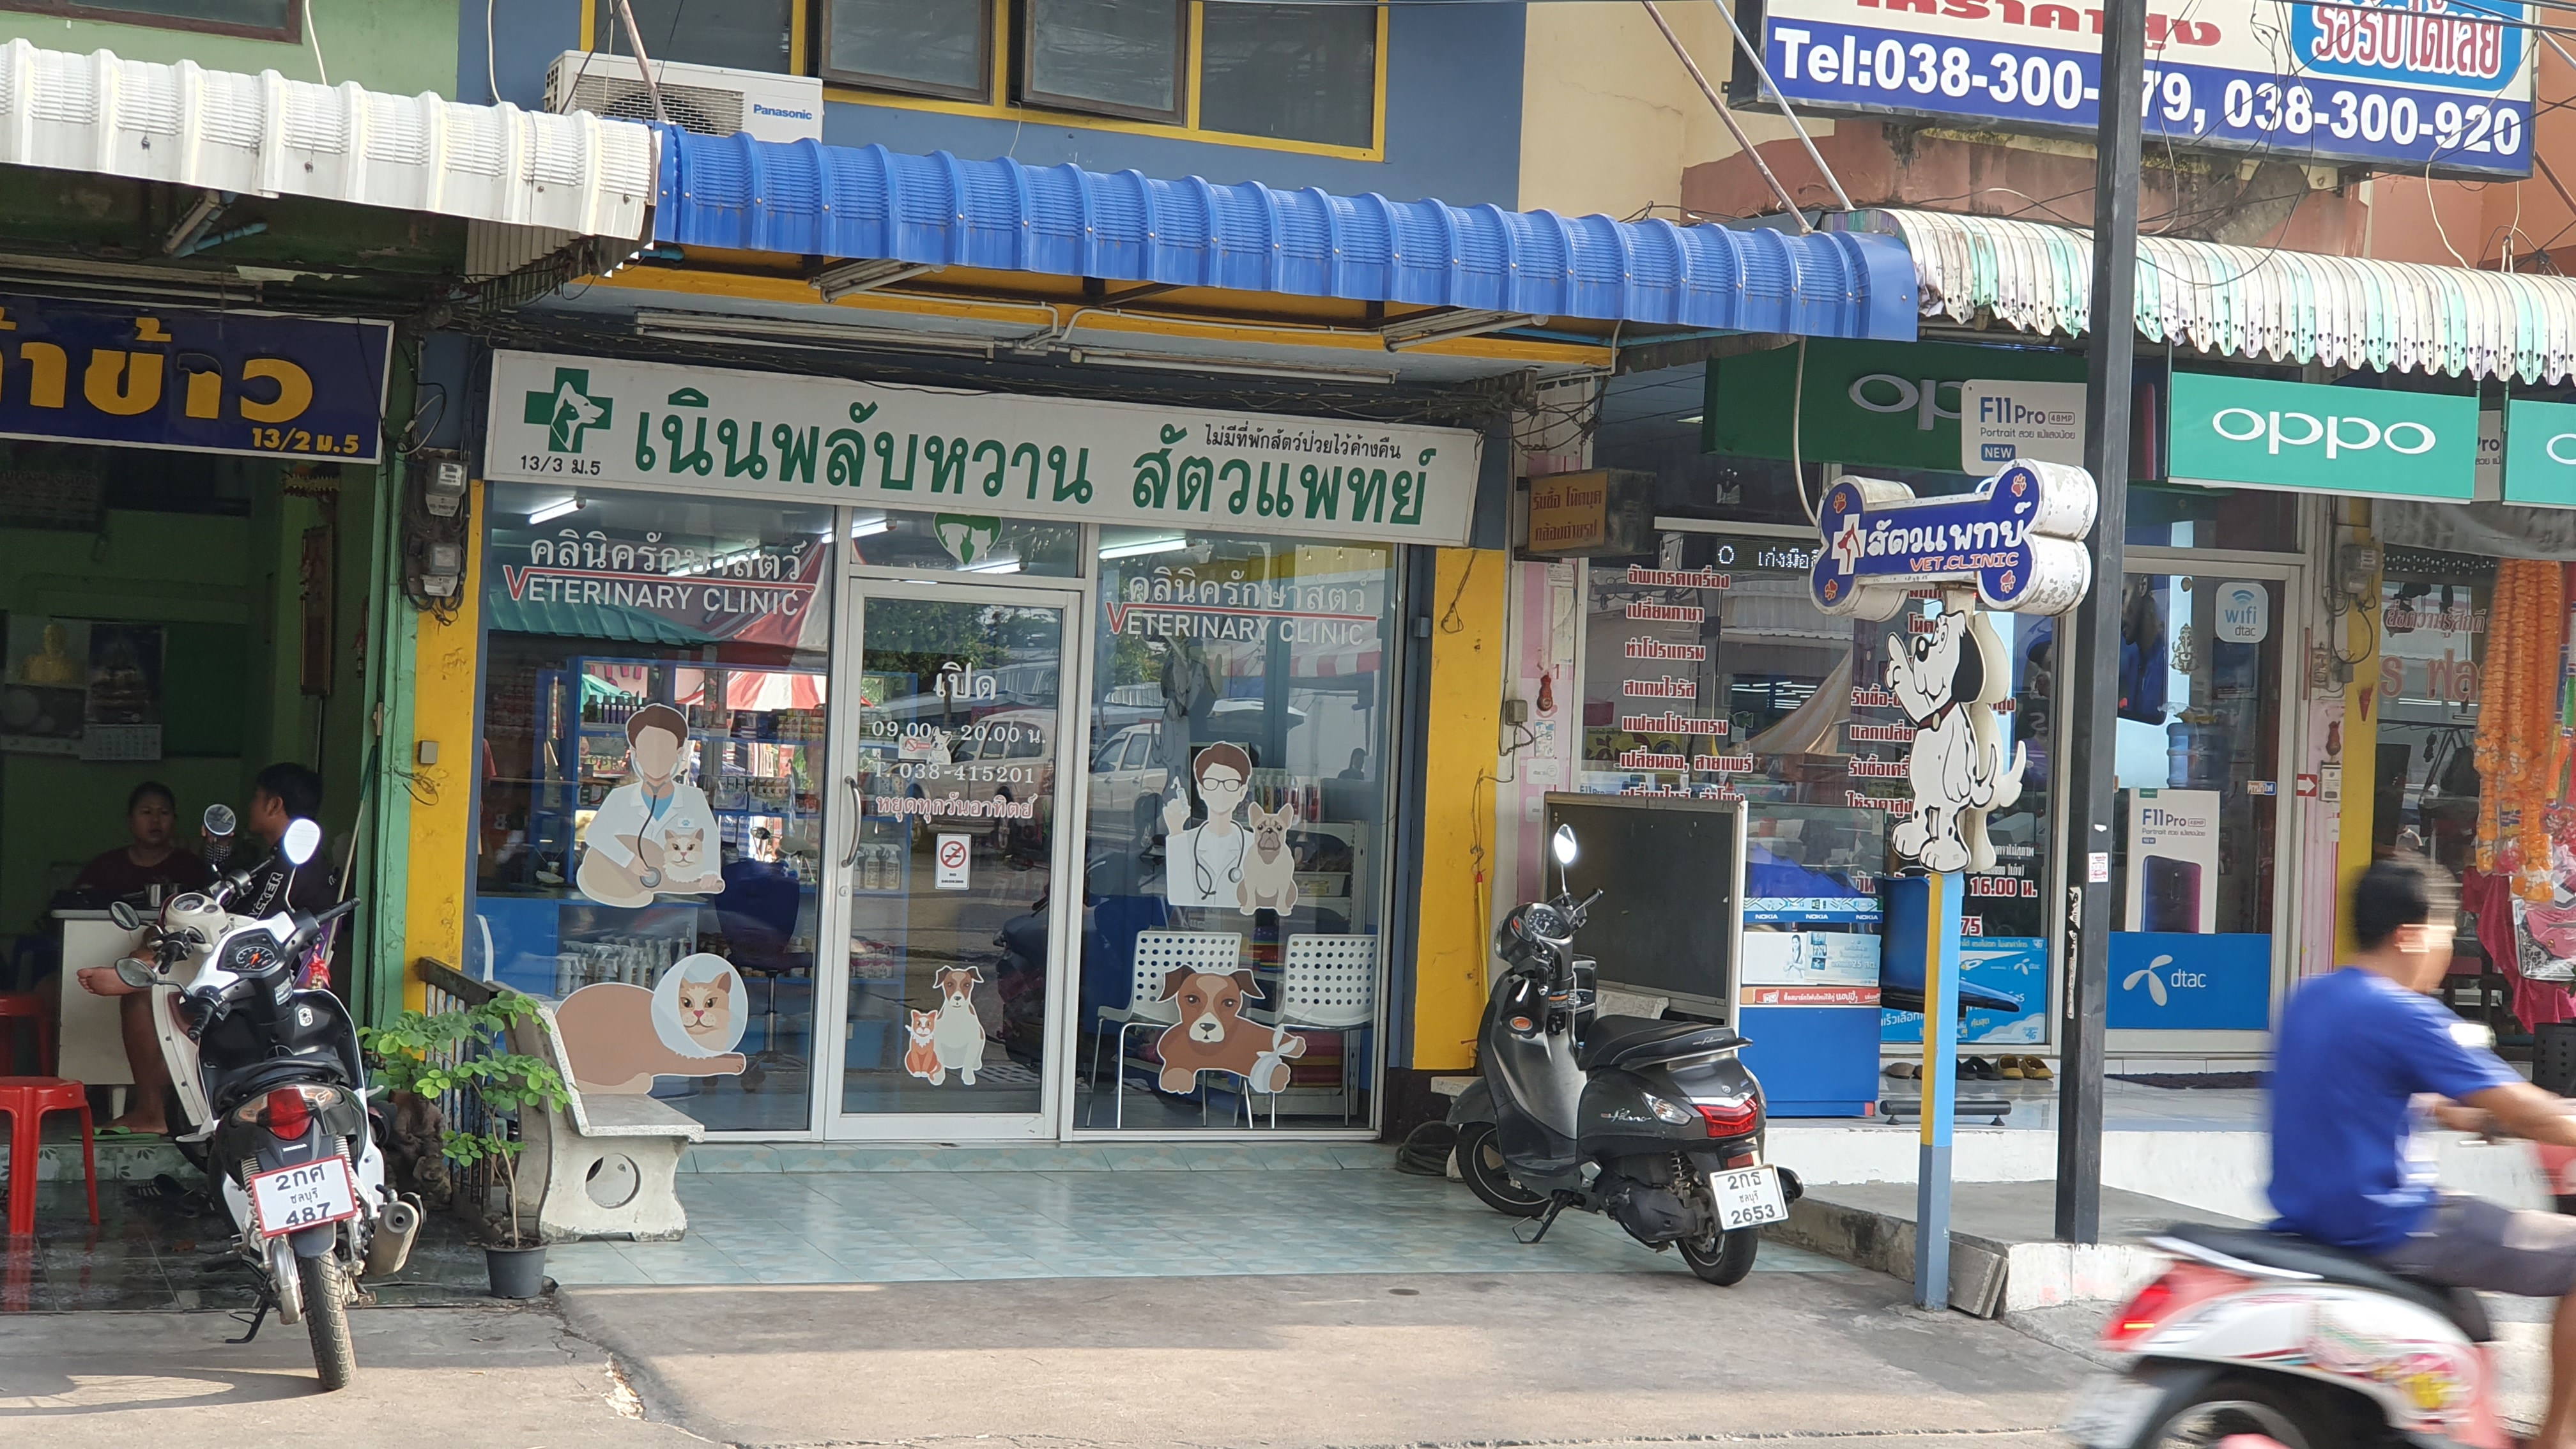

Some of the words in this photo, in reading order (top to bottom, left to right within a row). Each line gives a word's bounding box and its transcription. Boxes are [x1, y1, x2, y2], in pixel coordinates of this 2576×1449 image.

[2313, 0, 2501, 77] รอรบได้เลย
[1774, 27, 2205, 134] Tel:038-300-79,
[2224, 79, 2521, 155] 038-300-920
[753, 103, 813, 120] Panasonic
[1981, 397, 2011, 424] F11
[2015, 405, 2046, 424] Pro
[252, 427, 310, 451] 13/2
[317, 434, 359, 454] ม.5
[1205, 421, 1401, 460] ไม่มีที่พักสัตว์ป่วยไว้ค้างคืน
[1981, 427, 2016, 438] Portrait
[2212, 408, 2436, 459] oppo
[520, 454, 563, 473] 13/3
[571, 459, 601, 475] ม.5
[636, 387, 1093, 504] เนินพลับหวาน
[1133, 423, 1437, 525] สัตวแพทย์
[1984, 447, 2012, 458] NEW
[1867, 501, 2032, 557] สัตวแพทย์
[530, 528, 807, 580] คลินิครักษาสัตว์
[1910, 552, 2020, 572] VET.CLINIC
[1628, 564, 1730, 589] อัพเกรดเครื่อง
[503, 565, 693, 610] VETERINARY
[703, 588, 799, 616] CLINIC
[1627, 597, 1704, 623] เปลี่ยนภาษา
[2225, 606, 2256, 624] wifi
[1105, 602, 1271, 641] VETERINARY
[1280, 620, 1364, 647] CLINIC
[2235, 625, 2255, 636] dtac
[1625, 636, 1705, 661] ทำโปรแกรม
[935, 661, 996, 700] เปิด
[1623, 675, 1696, 699] สแกนไวรัส
[872, 721, 931, 737] 09.00
[961, 724, 1020, 742] 20.00
[1028, 729, 1046, 744] น.
[1622, 711, 1728, 735] แฟลชโปรแกรม
[1620, 746, 1690, 773] เปลี่ยนจอ,
[900, 763, 1034, 784] 038-415201
[875, 792, 1038, 824] หยุดทุกวันอาทิตย์
[2142, 808, 2164, 826] F11
[2165, 814, 2187, 827] Pro
[1970, 877, 2017, 897] 16.00
[2021, 880, 2038, 898] น.
[2170, 968, 2207, 988] dtac
[275, 1164, 325, 1191] 2กศ
[1728, 1171, 1761, 1190] 2กธ
[290, 1187, 318, 1204] ชลบุรี
[1739, 1190, 1759, 1204] ชลบุรี
[286, 1202, 331, 1225] 487
[1731, 1204, 1775, 1225] 2653
